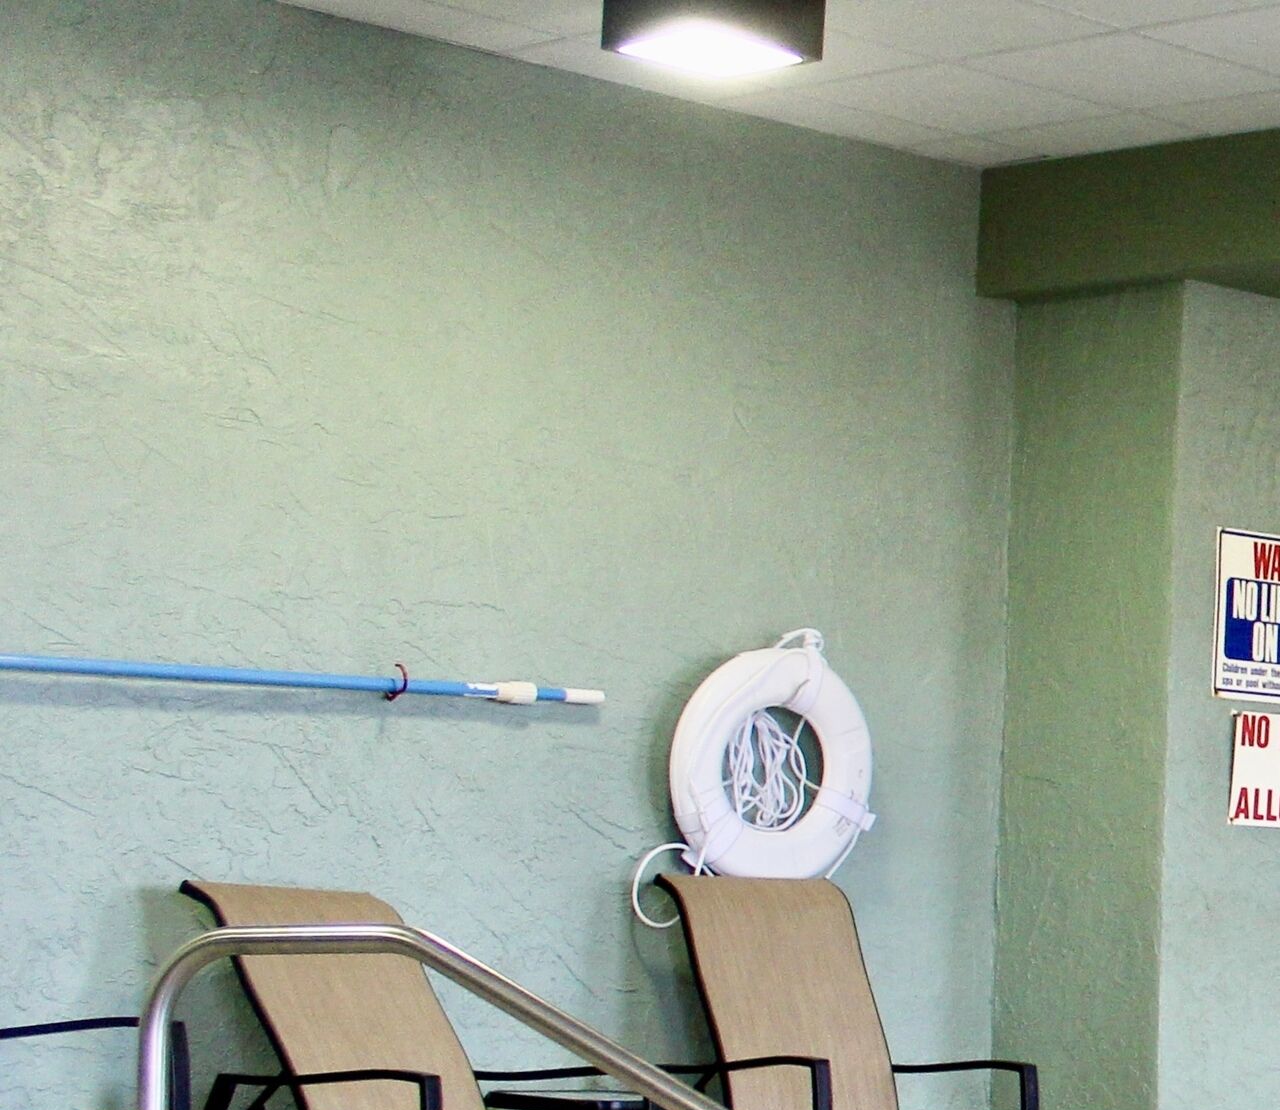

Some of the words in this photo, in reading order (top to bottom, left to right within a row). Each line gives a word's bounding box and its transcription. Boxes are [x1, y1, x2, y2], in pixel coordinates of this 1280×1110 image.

[1232, 579, 1259, 621] NO
[1251, 621, 1279, 664] ON
[1250, 667, 1268, 676] under
[1271, 668, 1280, 678] the
[1241, 714, 1270, 748] NO
